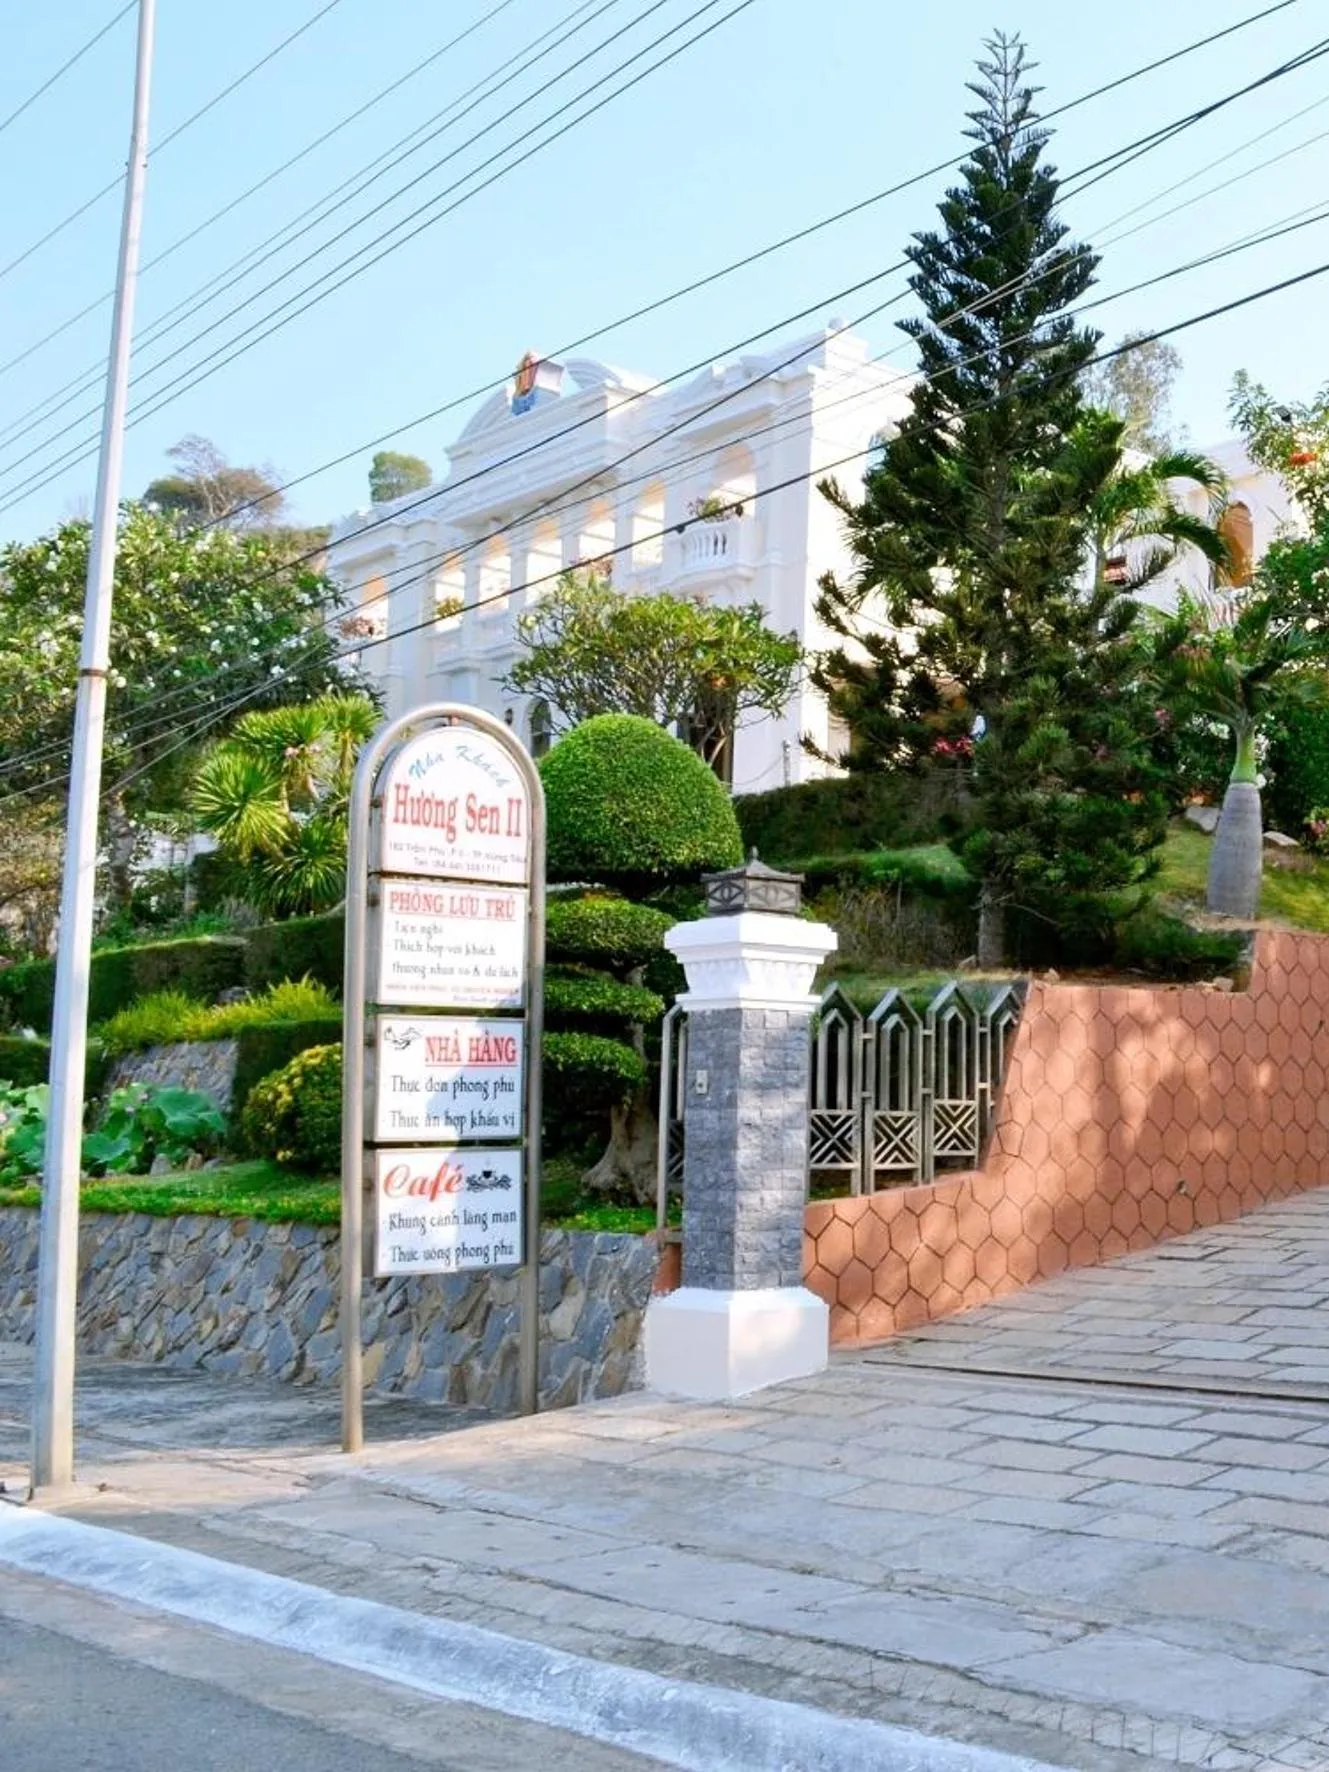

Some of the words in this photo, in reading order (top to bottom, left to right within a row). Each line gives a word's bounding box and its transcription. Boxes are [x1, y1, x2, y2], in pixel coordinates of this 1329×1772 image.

[466, 792, 500, 834] Sen
[506, 798, 522, 837] II
[389, 888, 444, 913] PHÒNG
[452, 1075, 489, 1101] phong
[383, 1160, 464, 1202] Café
[455, 1242, 490, 1265] phong
